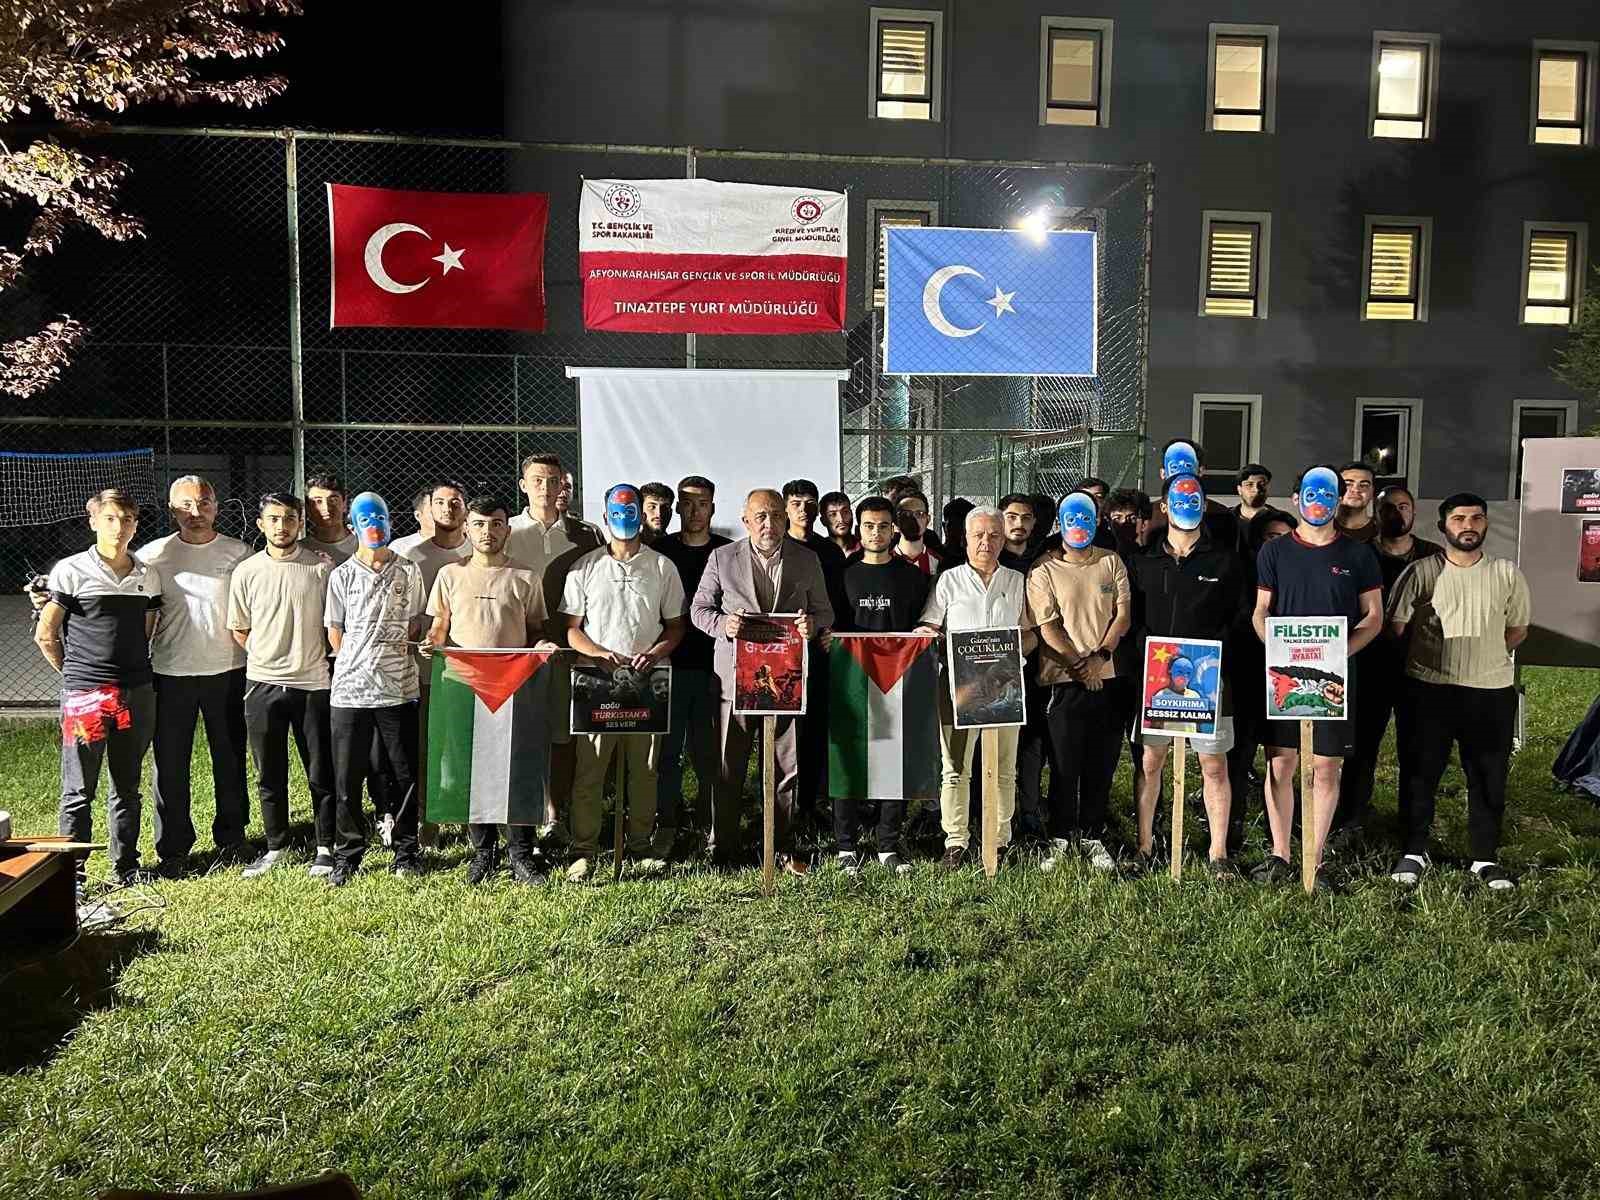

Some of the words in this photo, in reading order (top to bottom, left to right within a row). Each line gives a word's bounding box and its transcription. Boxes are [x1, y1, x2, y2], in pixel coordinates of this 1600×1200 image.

[592, 222, 605, 230] T.C.
[607, 222, 641, 231] GENÇLİK
[643, 223, 654, 231] VE
[806, 226, 839, 234] YURTLAR
[592, 231, 611, 239] SPOR
[612, 231, 654, 240] BAKANLIĞI
[795, 234, 841, 243] MÜDÜRLÜĞÜ
[589, 268, 679, 281] AFYONKARAHİSAR
[724, 271, 737, 281] VE
[739, 270, 765, 281] SPOR
[778, 269, 841, 283] MÜDÜRLÜĞÜ
[614, 301, 686, 314] TINAZTEPE
[690, 301, 726, 315] YURT
[729, 299, 818, 316] MÜDÜRLÜĞÜ
[957, 642, 1014, 655] ÇOCUKLARI
[600, 702, 621, 710] DOĞU
[1155, 699, 1206, 708] SOYKIRIMA
[1146, 709, 1179, 719] SESSİZ
[1180, 710, 1213, 720] KALMA
